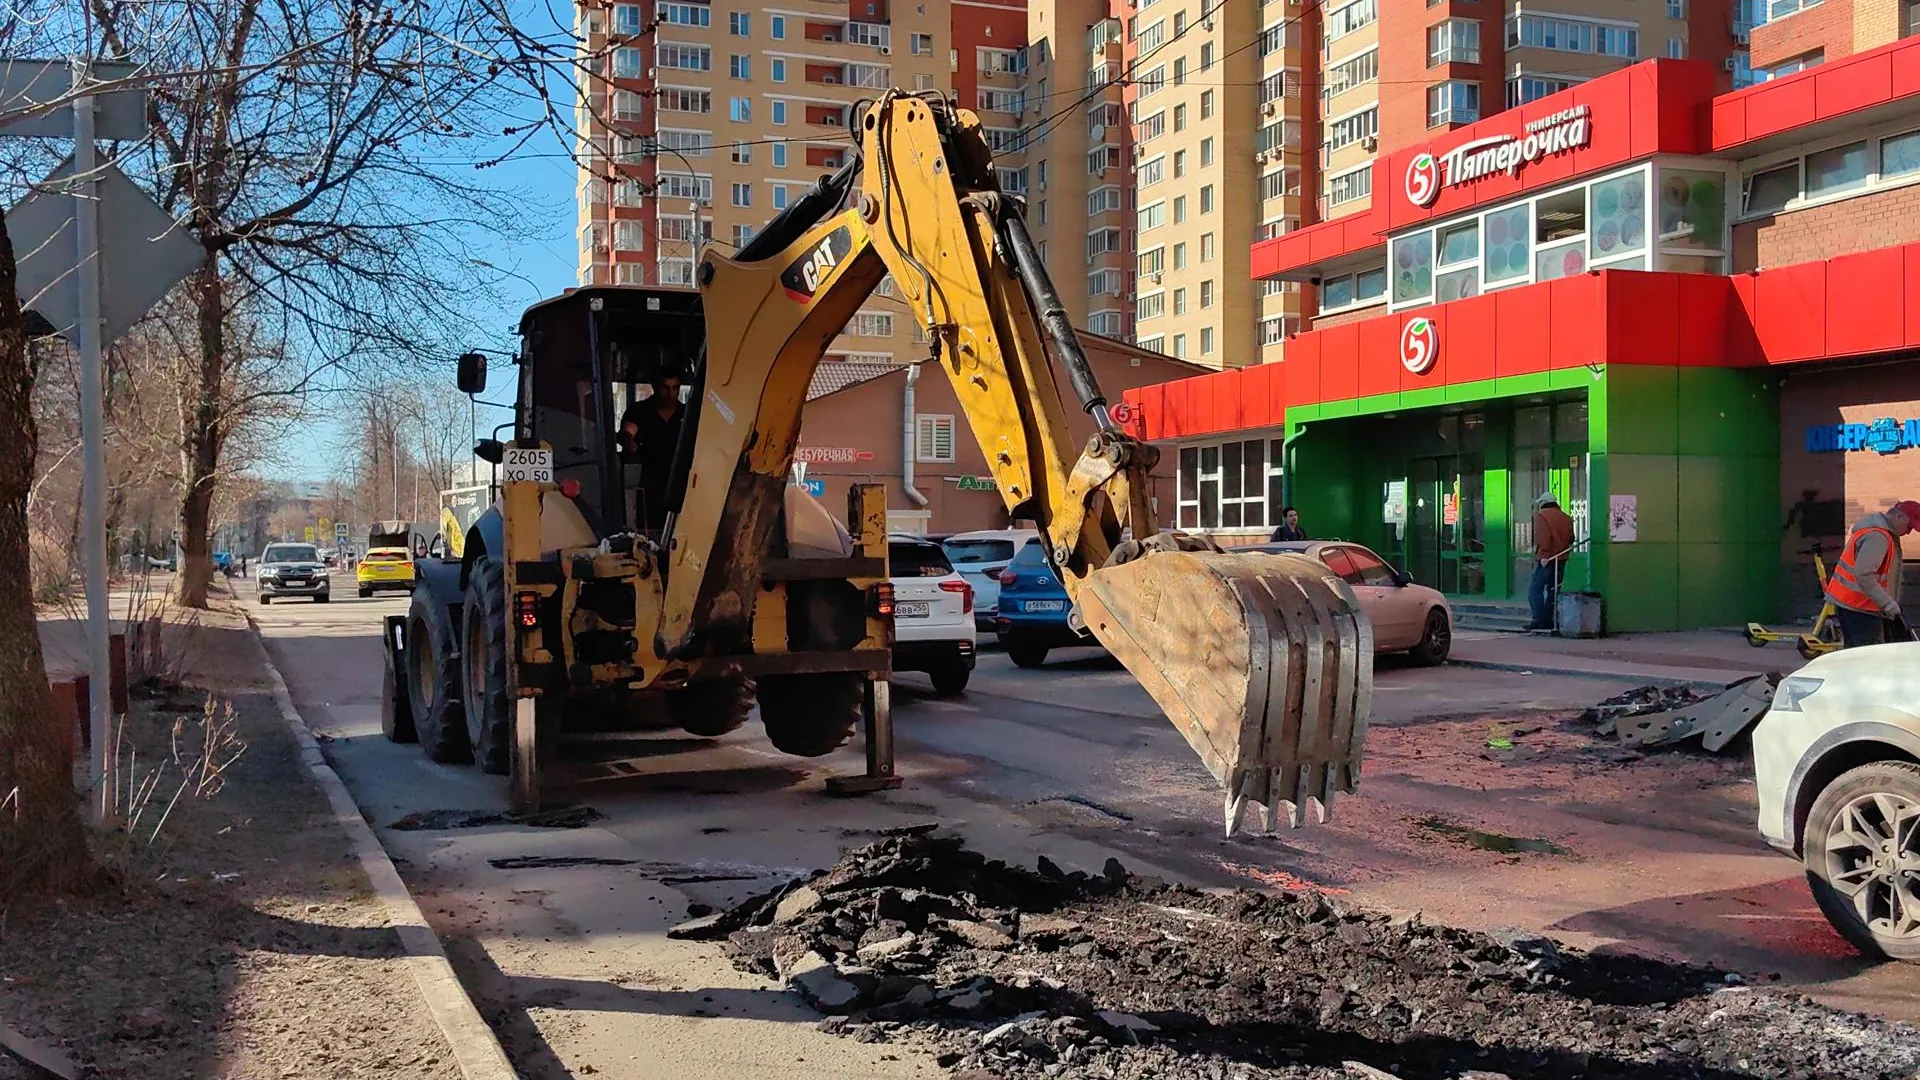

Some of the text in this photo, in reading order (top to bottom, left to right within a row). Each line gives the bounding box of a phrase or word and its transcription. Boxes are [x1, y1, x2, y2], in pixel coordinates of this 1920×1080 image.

[1525, 105, 1585, 133] УНИВЕРСАМ
[803, 236, 836, 292] CAT
[509, 451, 547, 465] 2605
[534, 470, 549, 482] 50
[913, 604, 926, 612] 250
